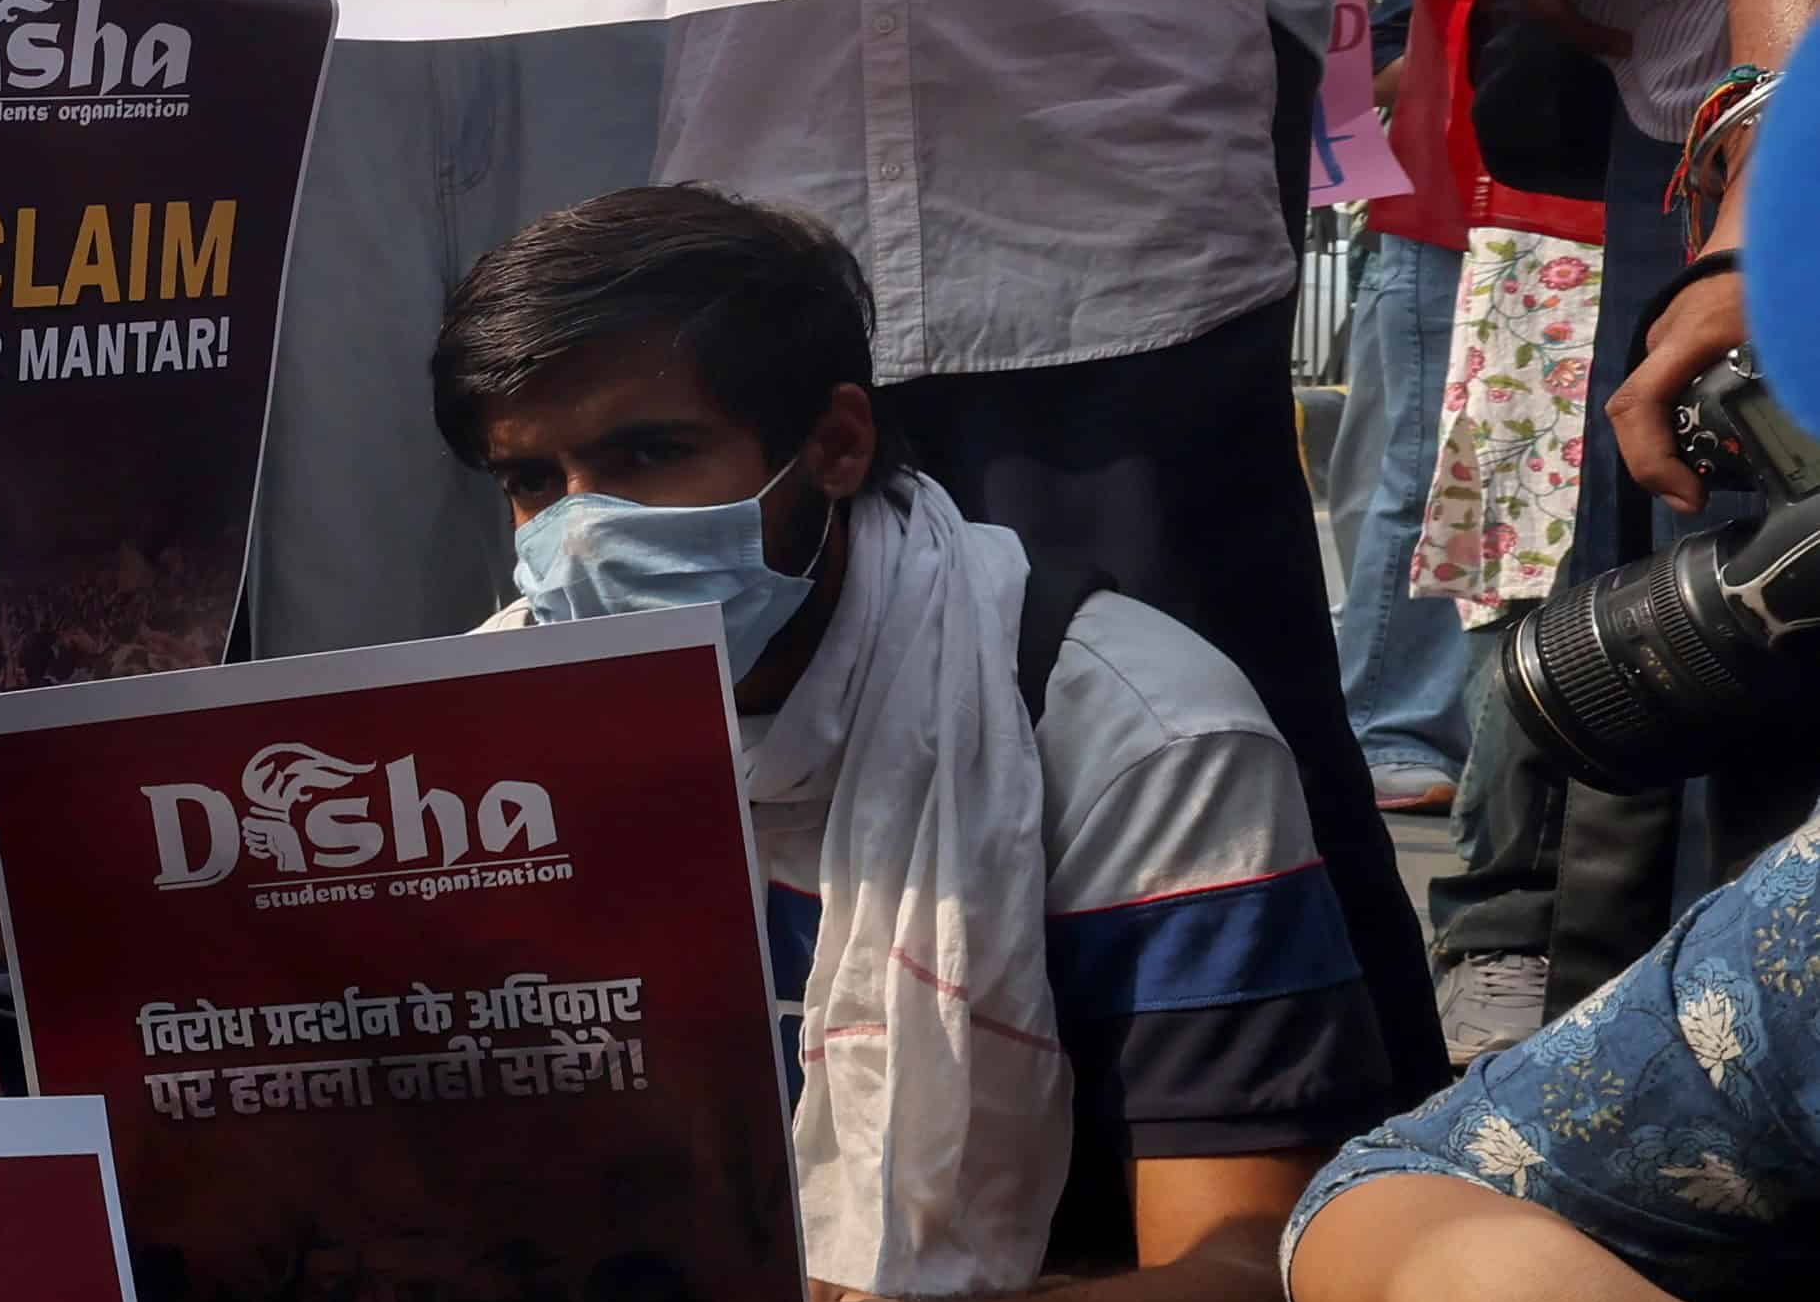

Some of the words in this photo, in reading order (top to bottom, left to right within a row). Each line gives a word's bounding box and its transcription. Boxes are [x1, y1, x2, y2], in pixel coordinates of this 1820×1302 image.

[57, 99, 190, 126] organization
[17, 316, 231, 382] MANTAR!
[140, 742, 558, 890] Disha
[389, 861, 573, 899] organization
[136, 998, 256, 1057] विरोध
[259, 986, 402, 1049] प्रदर्शन
[406, 981, 455, 1035] के
[465, 973, 643, 1030] अधिकार
[144, 1067, 216, 1120] पर
[221, 1057, 375, 1115] हमला
[379, 1035, 492, 1102] नहीं
